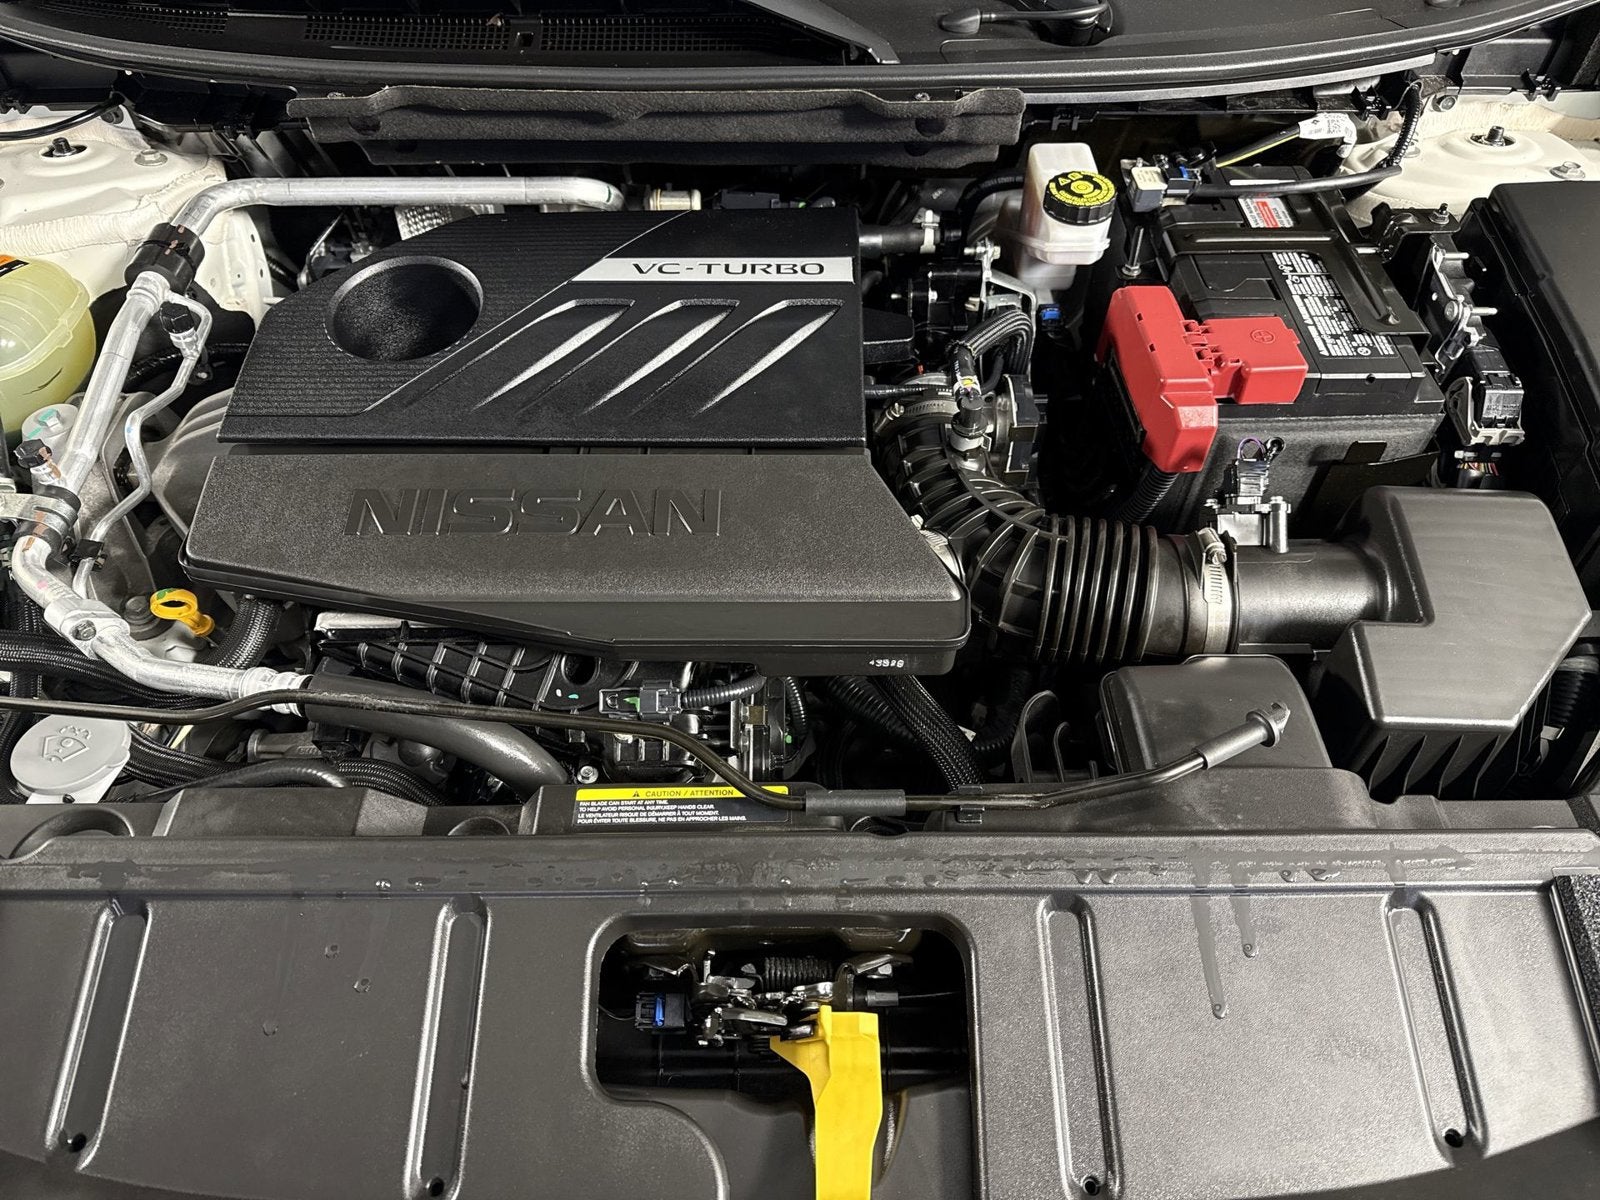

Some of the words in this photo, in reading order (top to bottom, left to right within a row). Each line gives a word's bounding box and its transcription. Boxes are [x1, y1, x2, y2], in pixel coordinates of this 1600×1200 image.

[632, 262, 825, 275] VC-TURBO
[343, 488, 722, 536] NISSAN
[690, 789, 734, 797] ATTENTION
